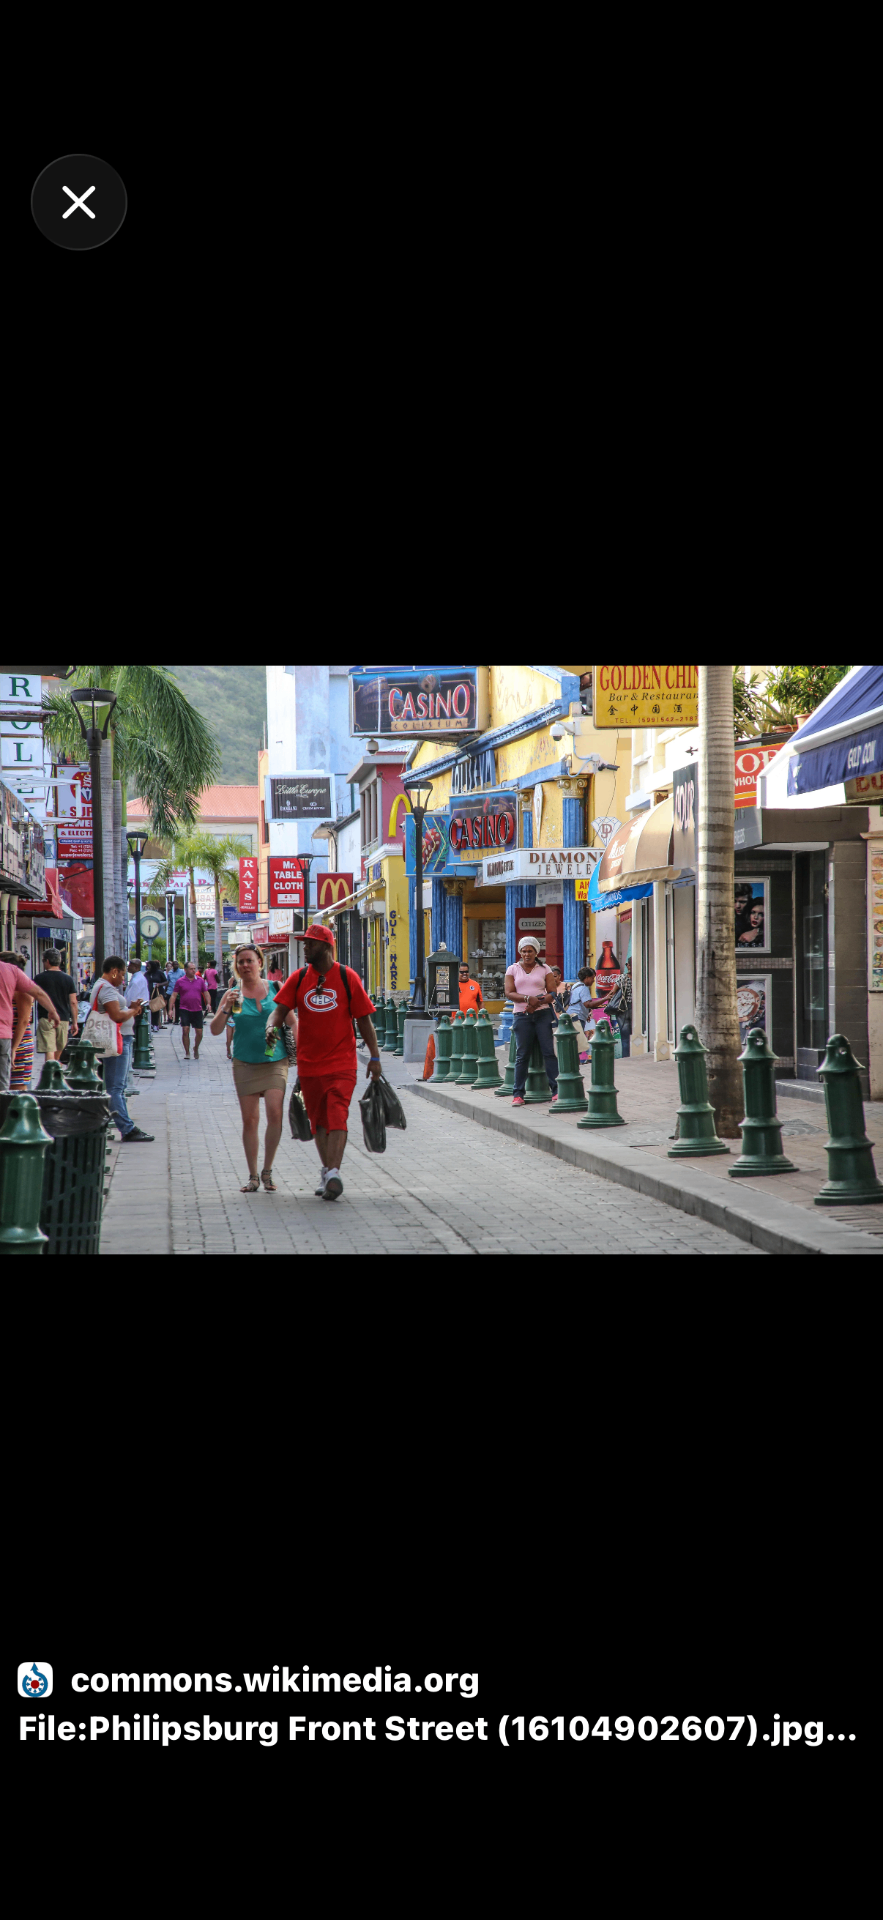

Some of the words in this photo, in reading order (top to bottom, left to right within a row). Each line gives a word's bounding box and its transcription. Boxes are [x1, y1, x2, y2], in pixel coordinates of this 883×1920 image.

[600, 666, 662, 691] GOLDEN
[389, 683, 471, 719] CASINO
[608, 693, 629, 702] Bar
[630, 693, 639, 701] &
[393, 720, 463, 730] COLISEUM
[275, 784, 300, 795] Little
[299, 783, 327, 798] Europe
[449, 811, 515, 850] CASINO
[282, 860, 297, 870] Mr.
[537, 863, 593, 875] JEWELE
[242, 859, 255, 901] RAY'S
[274, 870, 303, 880] TABLE
[273, 881, 304, 891] CLOTH
